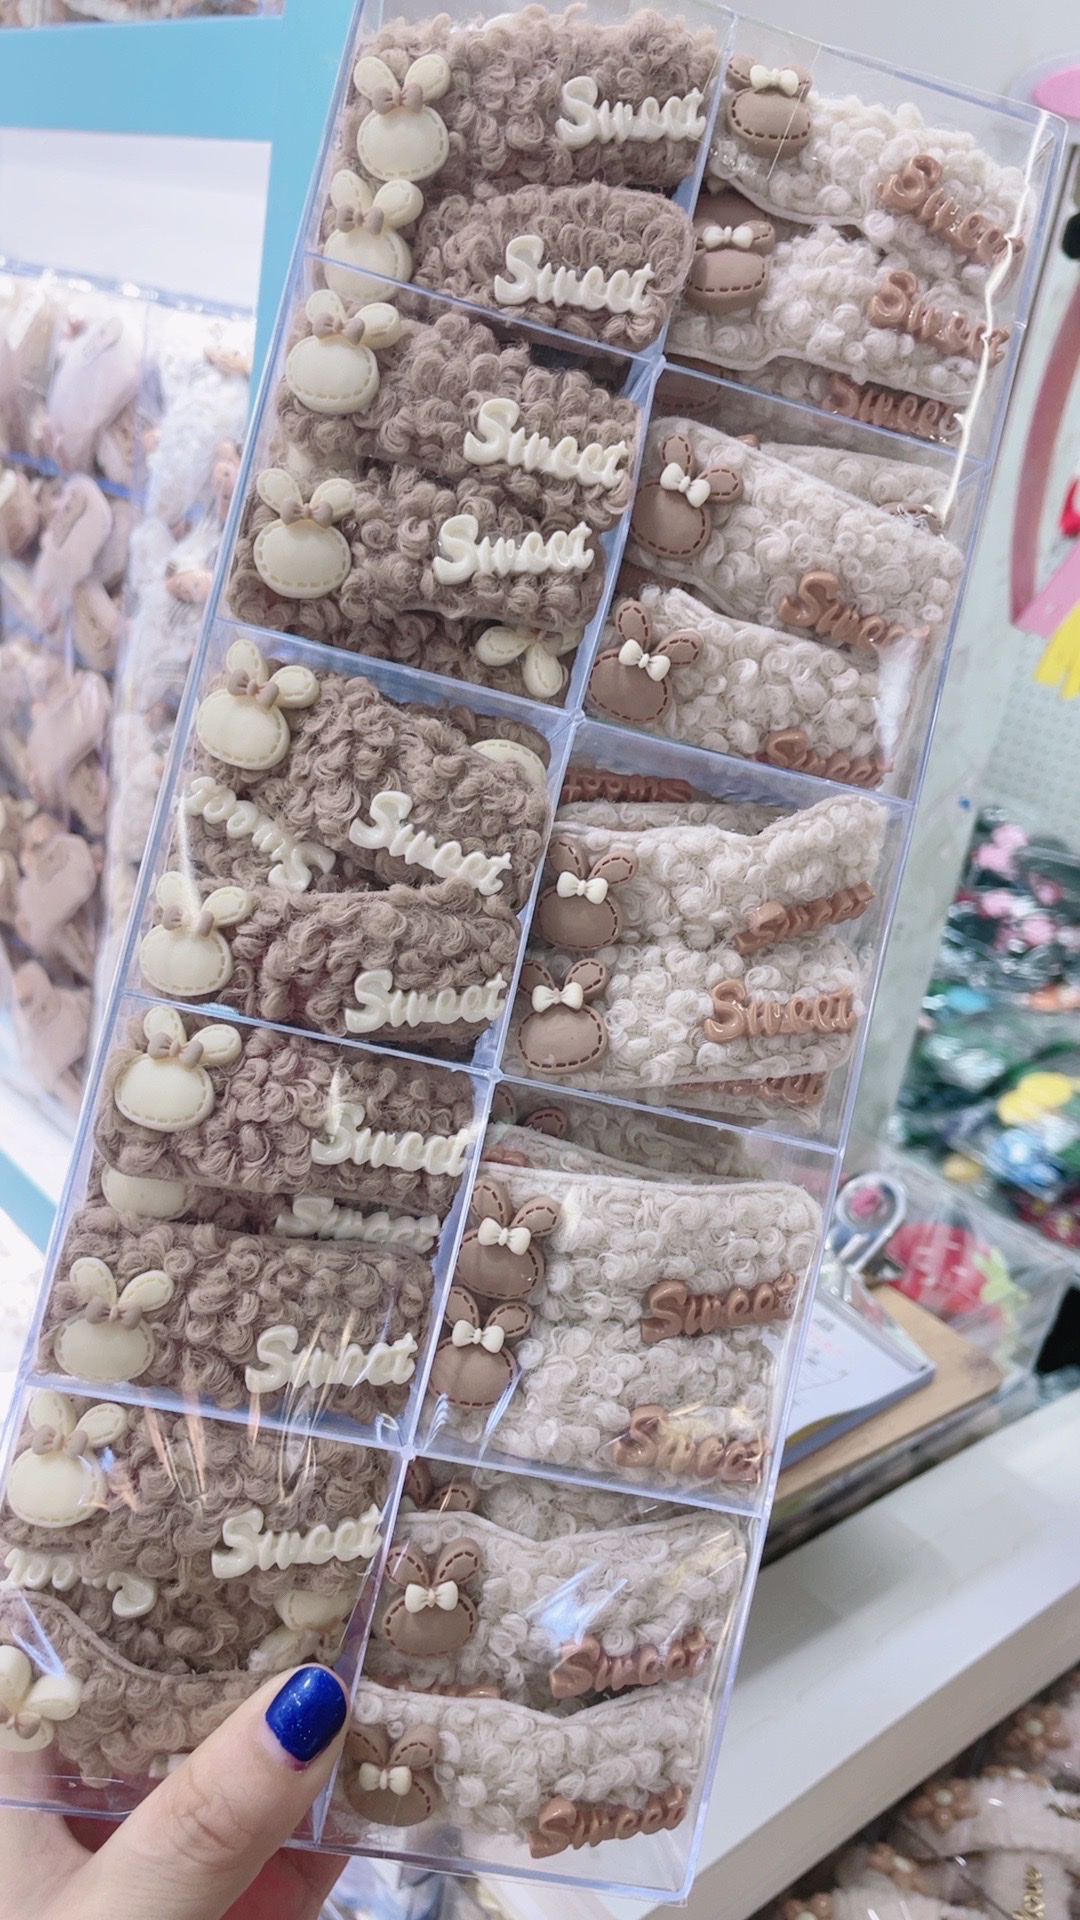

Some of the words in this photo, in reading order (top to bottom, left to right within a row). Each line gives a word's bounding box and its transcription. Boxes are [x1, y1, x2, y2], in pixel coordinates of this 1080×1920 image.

[555, 75, 707, 151] Sweet
[494, 234, 656, 314] Sweet
[462, 397, 630, 489] Sweet
[432, 513, 595, 586] Sweet
[348, 789, 513, 896] Sweet
[344, 968, 508, 1035] Sweet
[703, 977, 859, 1044] Sweet
[310, 1101, 471, 1178] Sweet
[245, 1323, 419, 1394] Sweet
[211, 1502, 384, 1580] Sweet
[0, 1547, 157, 1619] Seet
[529, 1784, 689, 1859] Sweet
